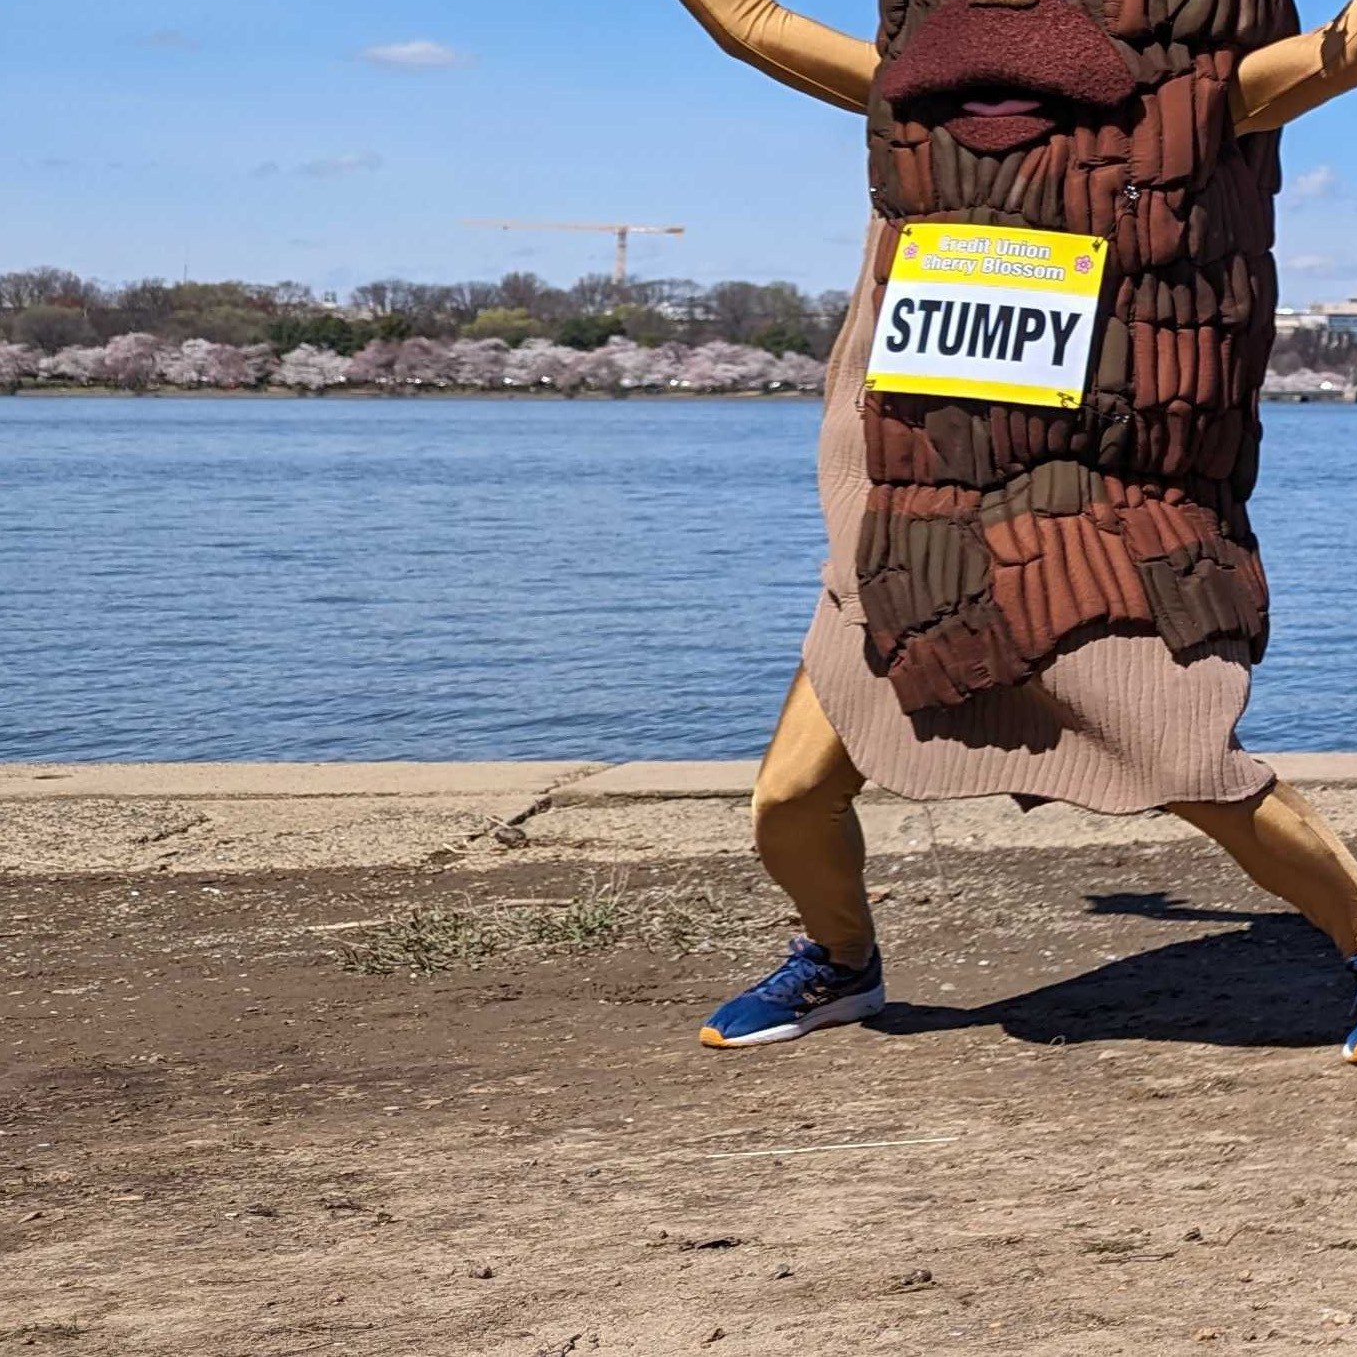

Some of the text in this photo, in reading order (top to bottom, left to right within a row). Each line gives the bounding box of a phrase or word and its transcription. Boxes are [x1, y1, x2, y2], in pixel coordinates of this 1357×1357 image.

[940, 236, 1051, 259] Credit Union
[922, 254, 1066, 280] Cherry Blossom
[886, 298, 1083, 367] STUMPY
